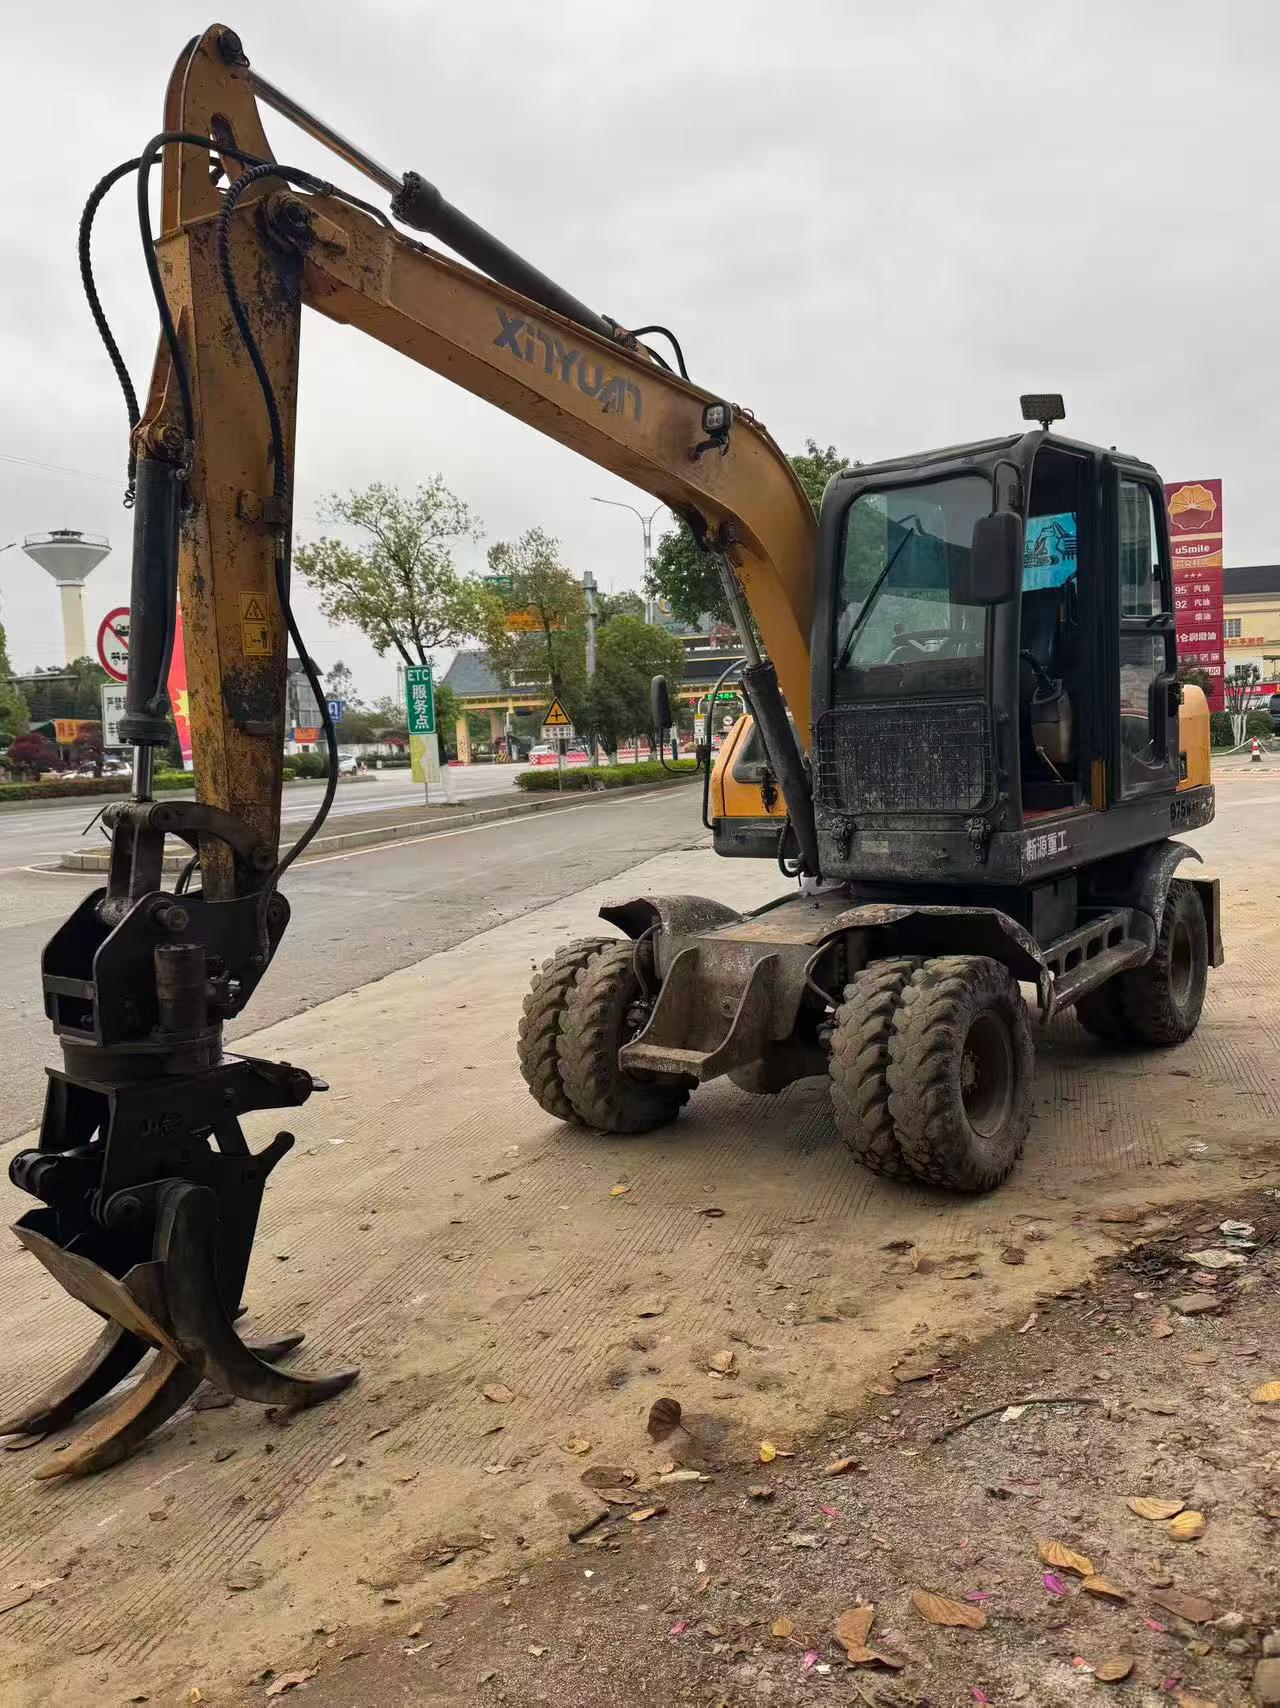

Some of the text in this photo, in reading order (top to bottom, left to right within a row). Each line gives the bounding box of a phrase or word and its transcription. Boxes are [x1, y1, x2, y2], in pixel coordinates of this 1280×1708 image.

[1175, 544, 1210, 554] uSmile
[1174, 584, 1210, 595] 95 汽油
[1175, 598, 1211, 609] 92 汽油
[407, 669, 429, 681] ETC
[412, 684, 430, 729] 服务点
